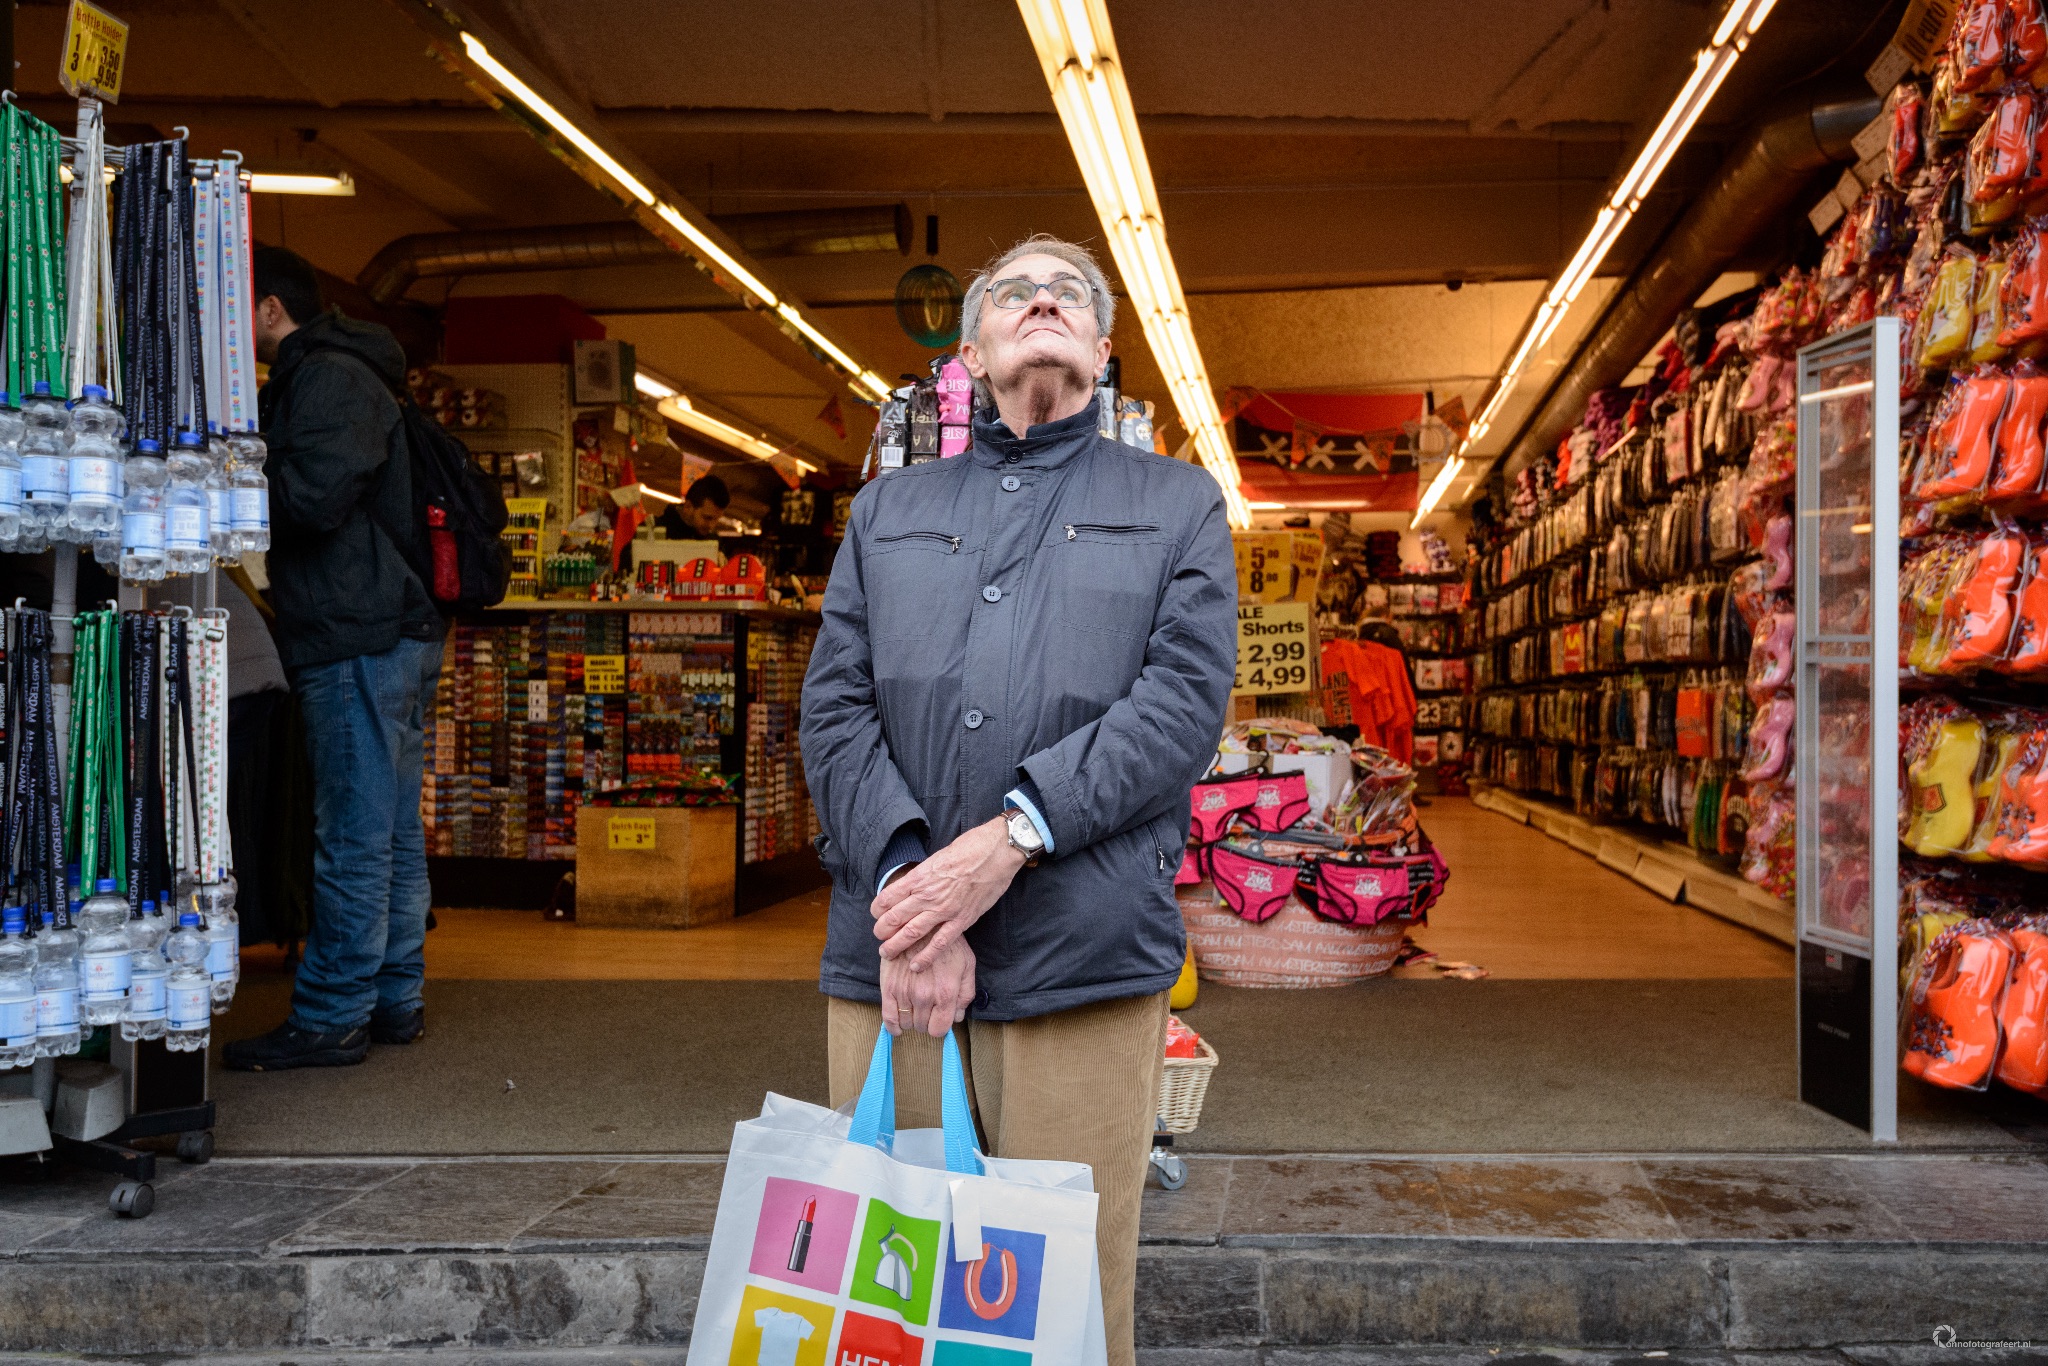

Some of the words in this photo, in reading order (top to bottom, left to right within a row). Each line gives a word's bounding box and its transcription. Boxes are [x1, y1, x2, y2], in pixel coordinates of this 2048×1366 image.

[1918, 2, 1946, 43] euro
[1243, 621, 1304, 636] Shorts
[1248, 642, 1305, 667] 2,99
[28, 657, 40, 722] AMSTERDAM
[140, 656, 151, 720] AMSTERDAM
[1249, 666, 1306, 691] 4,99
[1417, 702, 1441, 723] 23
[51, 803, 63, 869] AMSTERDAM
[132, 797, 144, 862] AMSTERDAM
